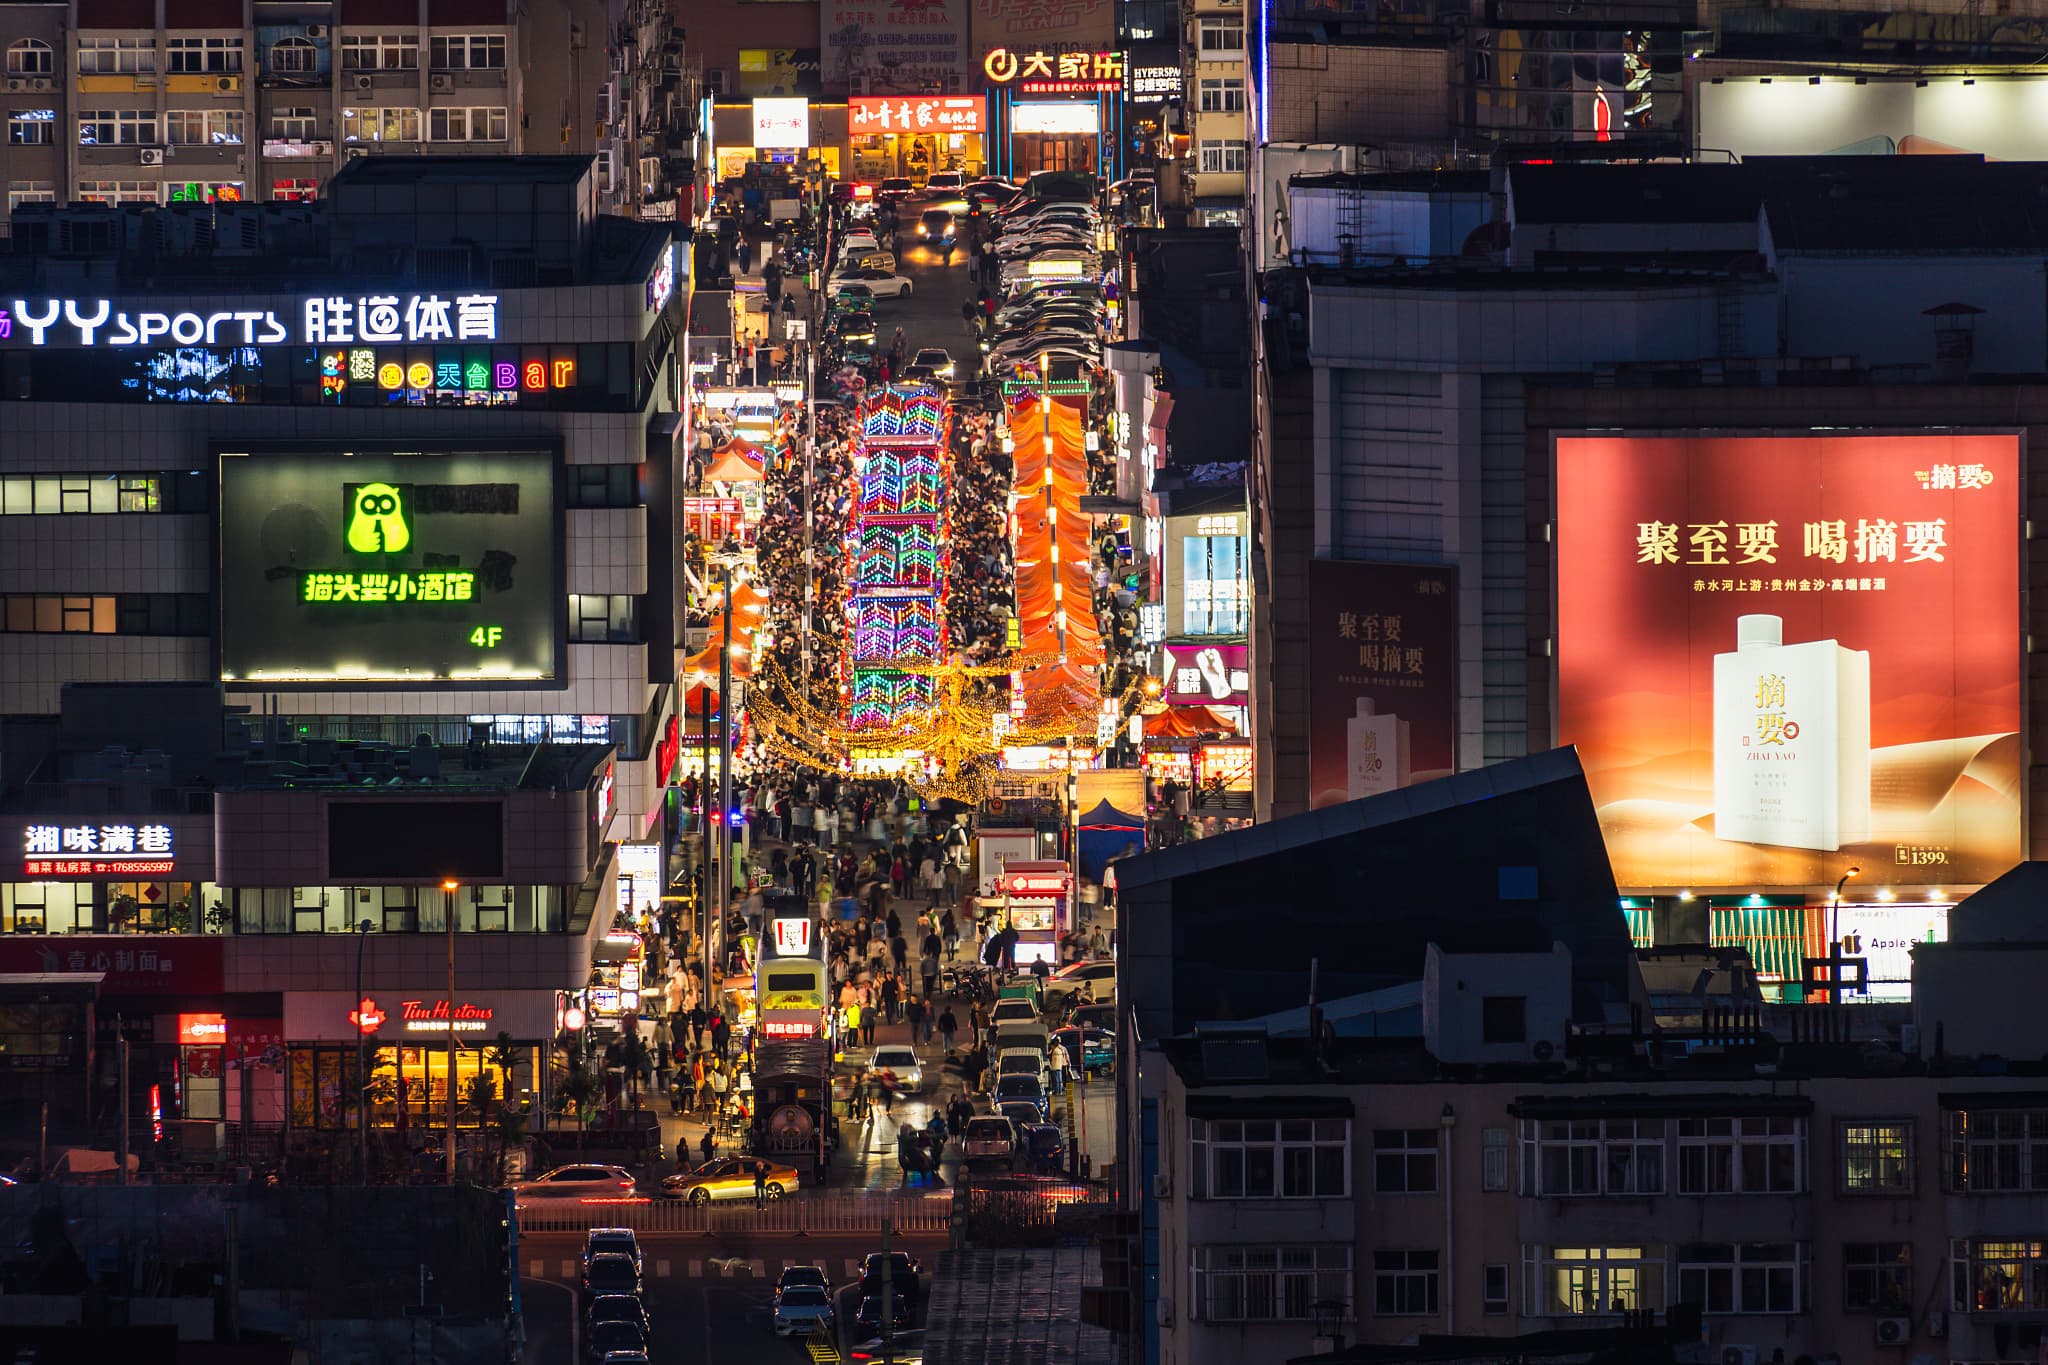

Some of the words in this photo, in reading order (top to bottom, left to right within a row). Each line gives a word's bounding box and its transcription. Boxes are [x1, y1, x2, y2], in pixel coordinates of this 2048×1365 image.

[1023, 51, 1123, 79] 大家乐
[304, 295, 498, 343] 胜道体育
[1930, 463, 1985, 490] 摘要
[1636, 519, 1781, 566] 聚至要
[1803, 519, 1947, 566] 喝摘要
[470, 627, 502, 648] 4F
[1338, 611, 1402, 642] 聚至要
[1359, 644, 1425, 675] 喝摘要
[1755, 673, 1788, 746] 摘要
[1746, 752, 1772, 761] ZHAI
[1774, 752, 1797, 761] YAO
[25, 825, 173, 852] 湘味满巷
[28, 862, 53, 873] 湘菜
[56, 862, 92, 873] 私房菜
[1871, 938, 1906, 950] Apple
[67, 949, 158, 972] 壹心制面
[401, 1000, 431, 1020] Tim
[431, 999, 493, 1020] Hrtons
